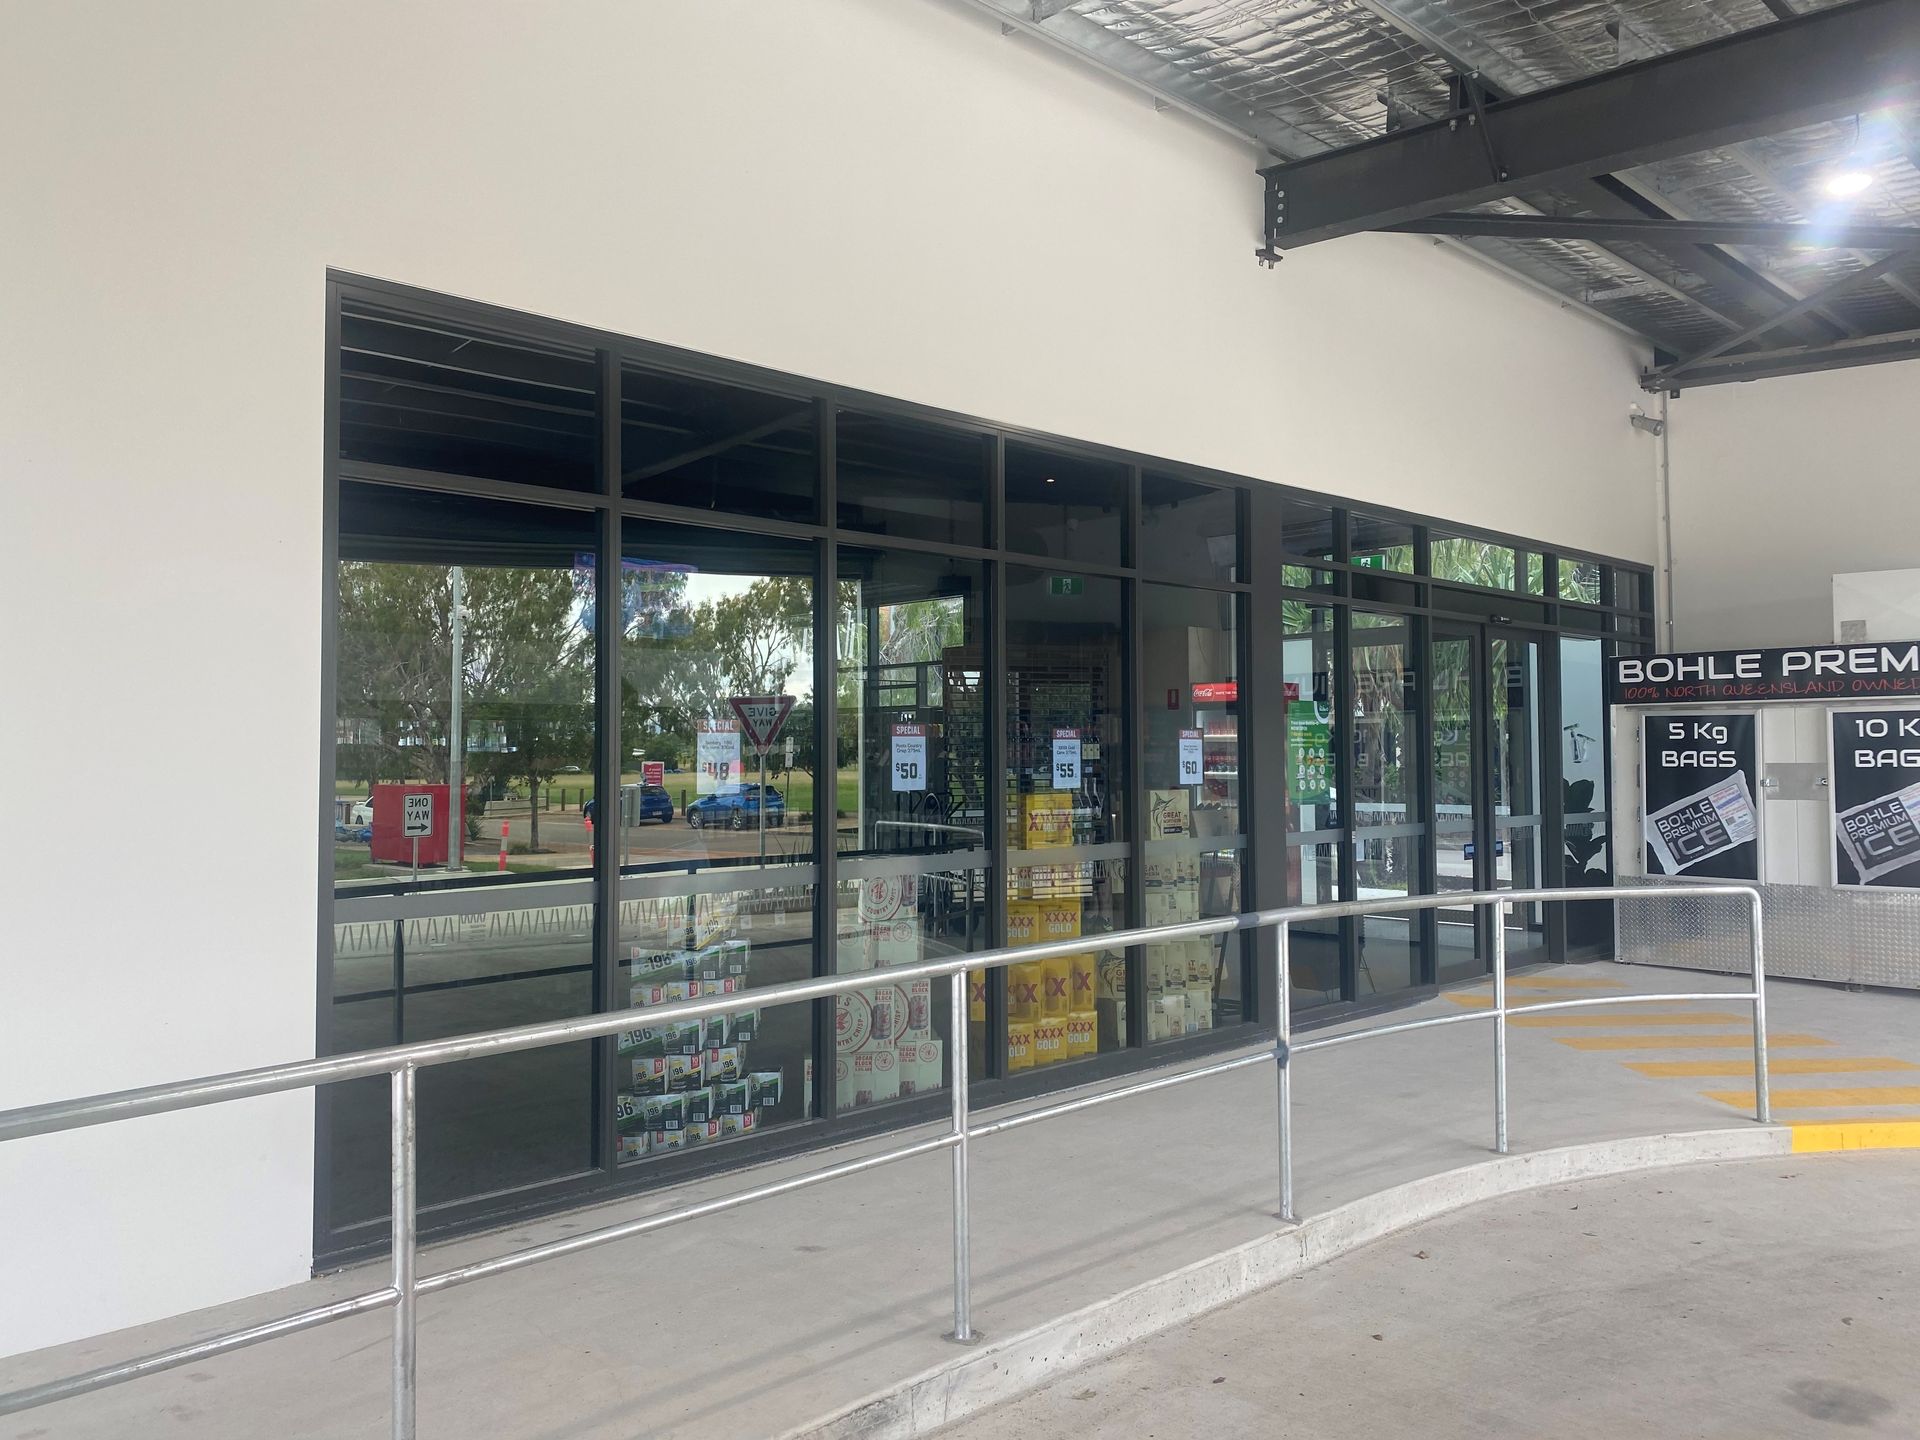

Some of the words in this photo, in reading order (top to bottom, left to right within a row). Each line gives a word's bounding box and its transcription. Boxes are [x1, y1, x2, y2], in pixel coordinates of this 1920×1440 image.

[1619, 654, 1762, 683] BOHLE
[1782, 645, 1919, 676] PREM
[1624, 687, 1659, 699] 100%
[1665, 685, 1716, 697] NORTH
[1722, 680, 1844, 695] QUEENSLAND
[703, 721, 734, 730] SCIAL
[896, 726, 921, 735] SPECIAL
[1855, 718, 1889, 738] 10
[1056, 730, 1076, 738] SPECIAL
[1182, 730, 1199, 738] SPECIAL
[1668, 722, 1686, 739] 5
[1694, 722, 1728, 744] Kg
[1662, 750, 1737, 767] BAGS
[896, 762, 918, 780] $50
[1056, 762, 1074, 778] $55
[1182, 760, 1197, 774] $60
[1163, 811, 1181, 819] GREAT
[1657, 800, 1713, 833] BOHLE
[1844, 801, 1904, 832] BOHLE
[1663, 812, 1718, 842] PREMIUM
[1850, 812, 1909, 842] PREMIUM
[1668, 821, 1728, 860] ICE
[1855, 821, 1919, 860] ICE
[1044, 912, 1077, 922] XXXX
[1049, 923, 1072, 933] GOLD
[623, 1028, 652, 1044] -196
[665, 1031, 677, 1040] 196
[1034, 1027, 1064, 1039] XXXX
[1068, 1033, 1090, 1043] GOLD
[1037, 1040, 1060, 1050] GOLD
[722, 1059, 734, 1068] 196
[635, 1071, 647, 1080] 196
[672, 1066, 684, 1076] 196
[647, 1106, 660, 1116] 196
[725, 1125, 737, 1134] 196
